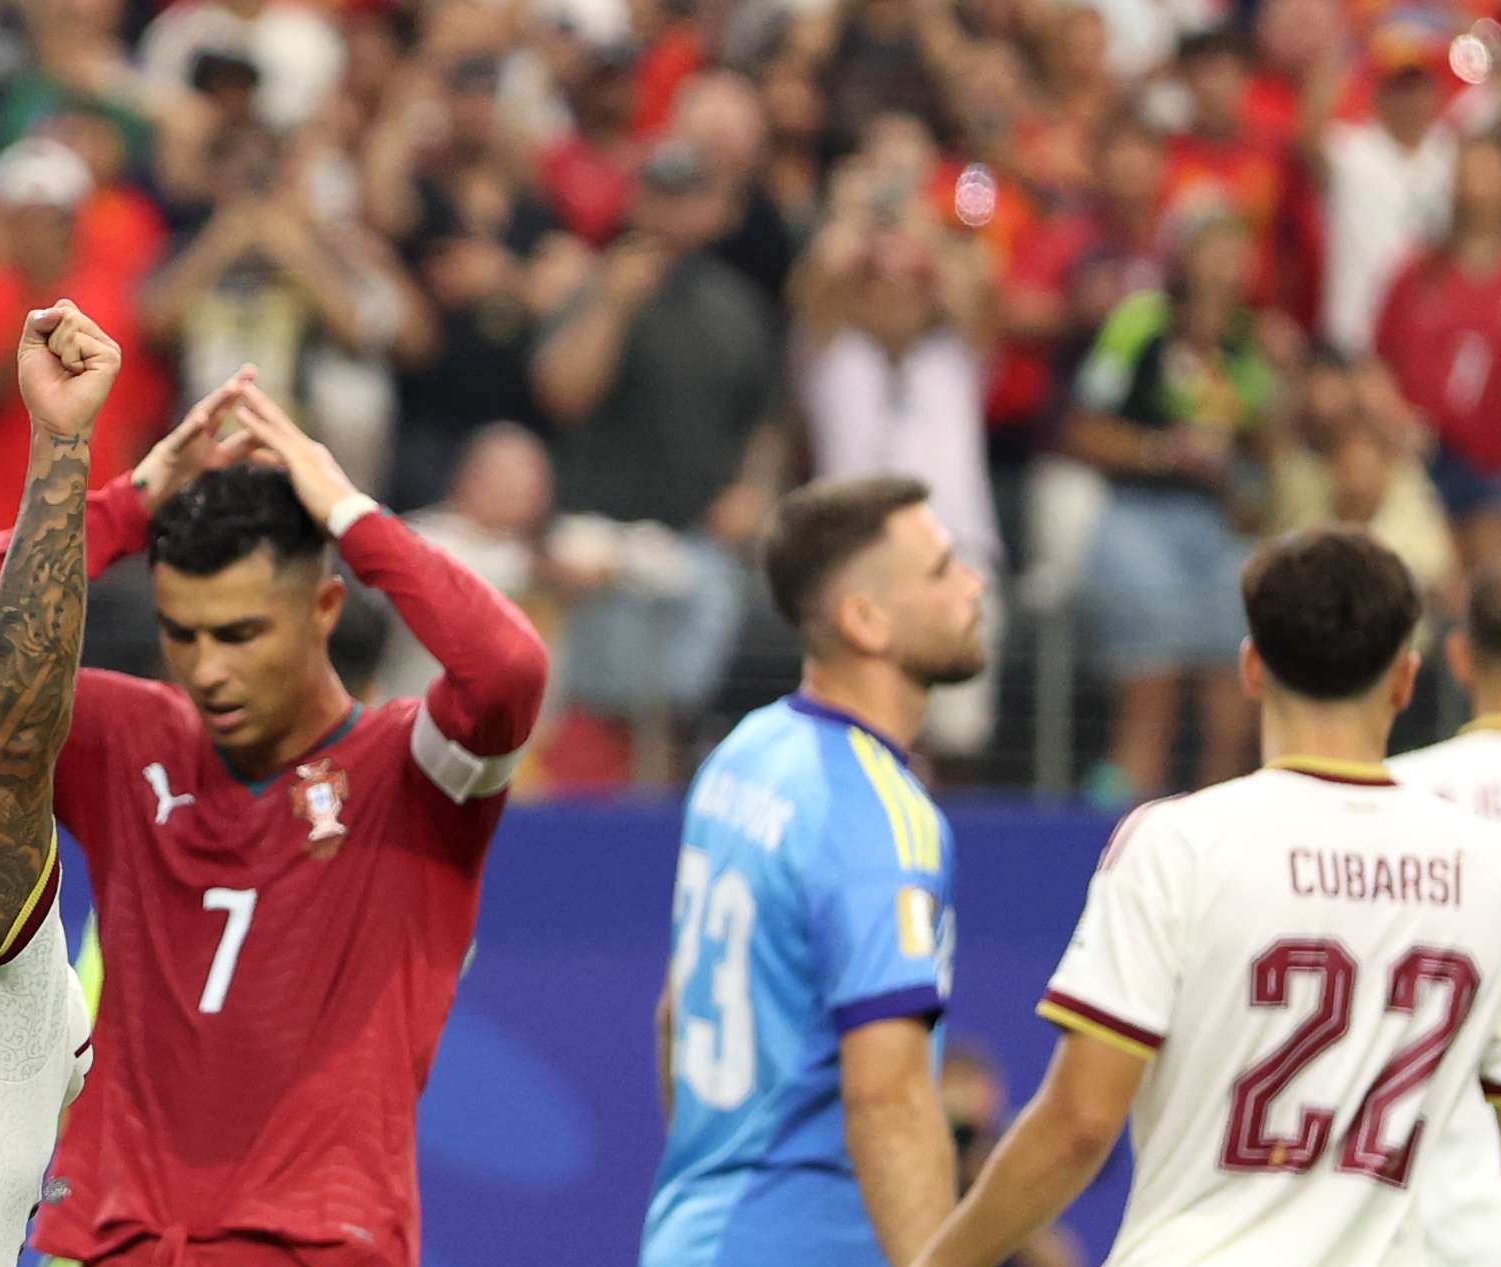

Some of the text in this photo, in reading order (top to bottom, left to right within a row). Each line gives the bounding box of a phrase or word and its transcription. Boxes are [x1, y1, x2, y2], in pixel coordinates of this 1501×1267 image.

[199, 887, 257, 1014] 7
[1289, 847, 1464, 907] CUBARSÍ
[672, 844, 756, 1111] 23
[1218, 937, 1481, 1190] 22
